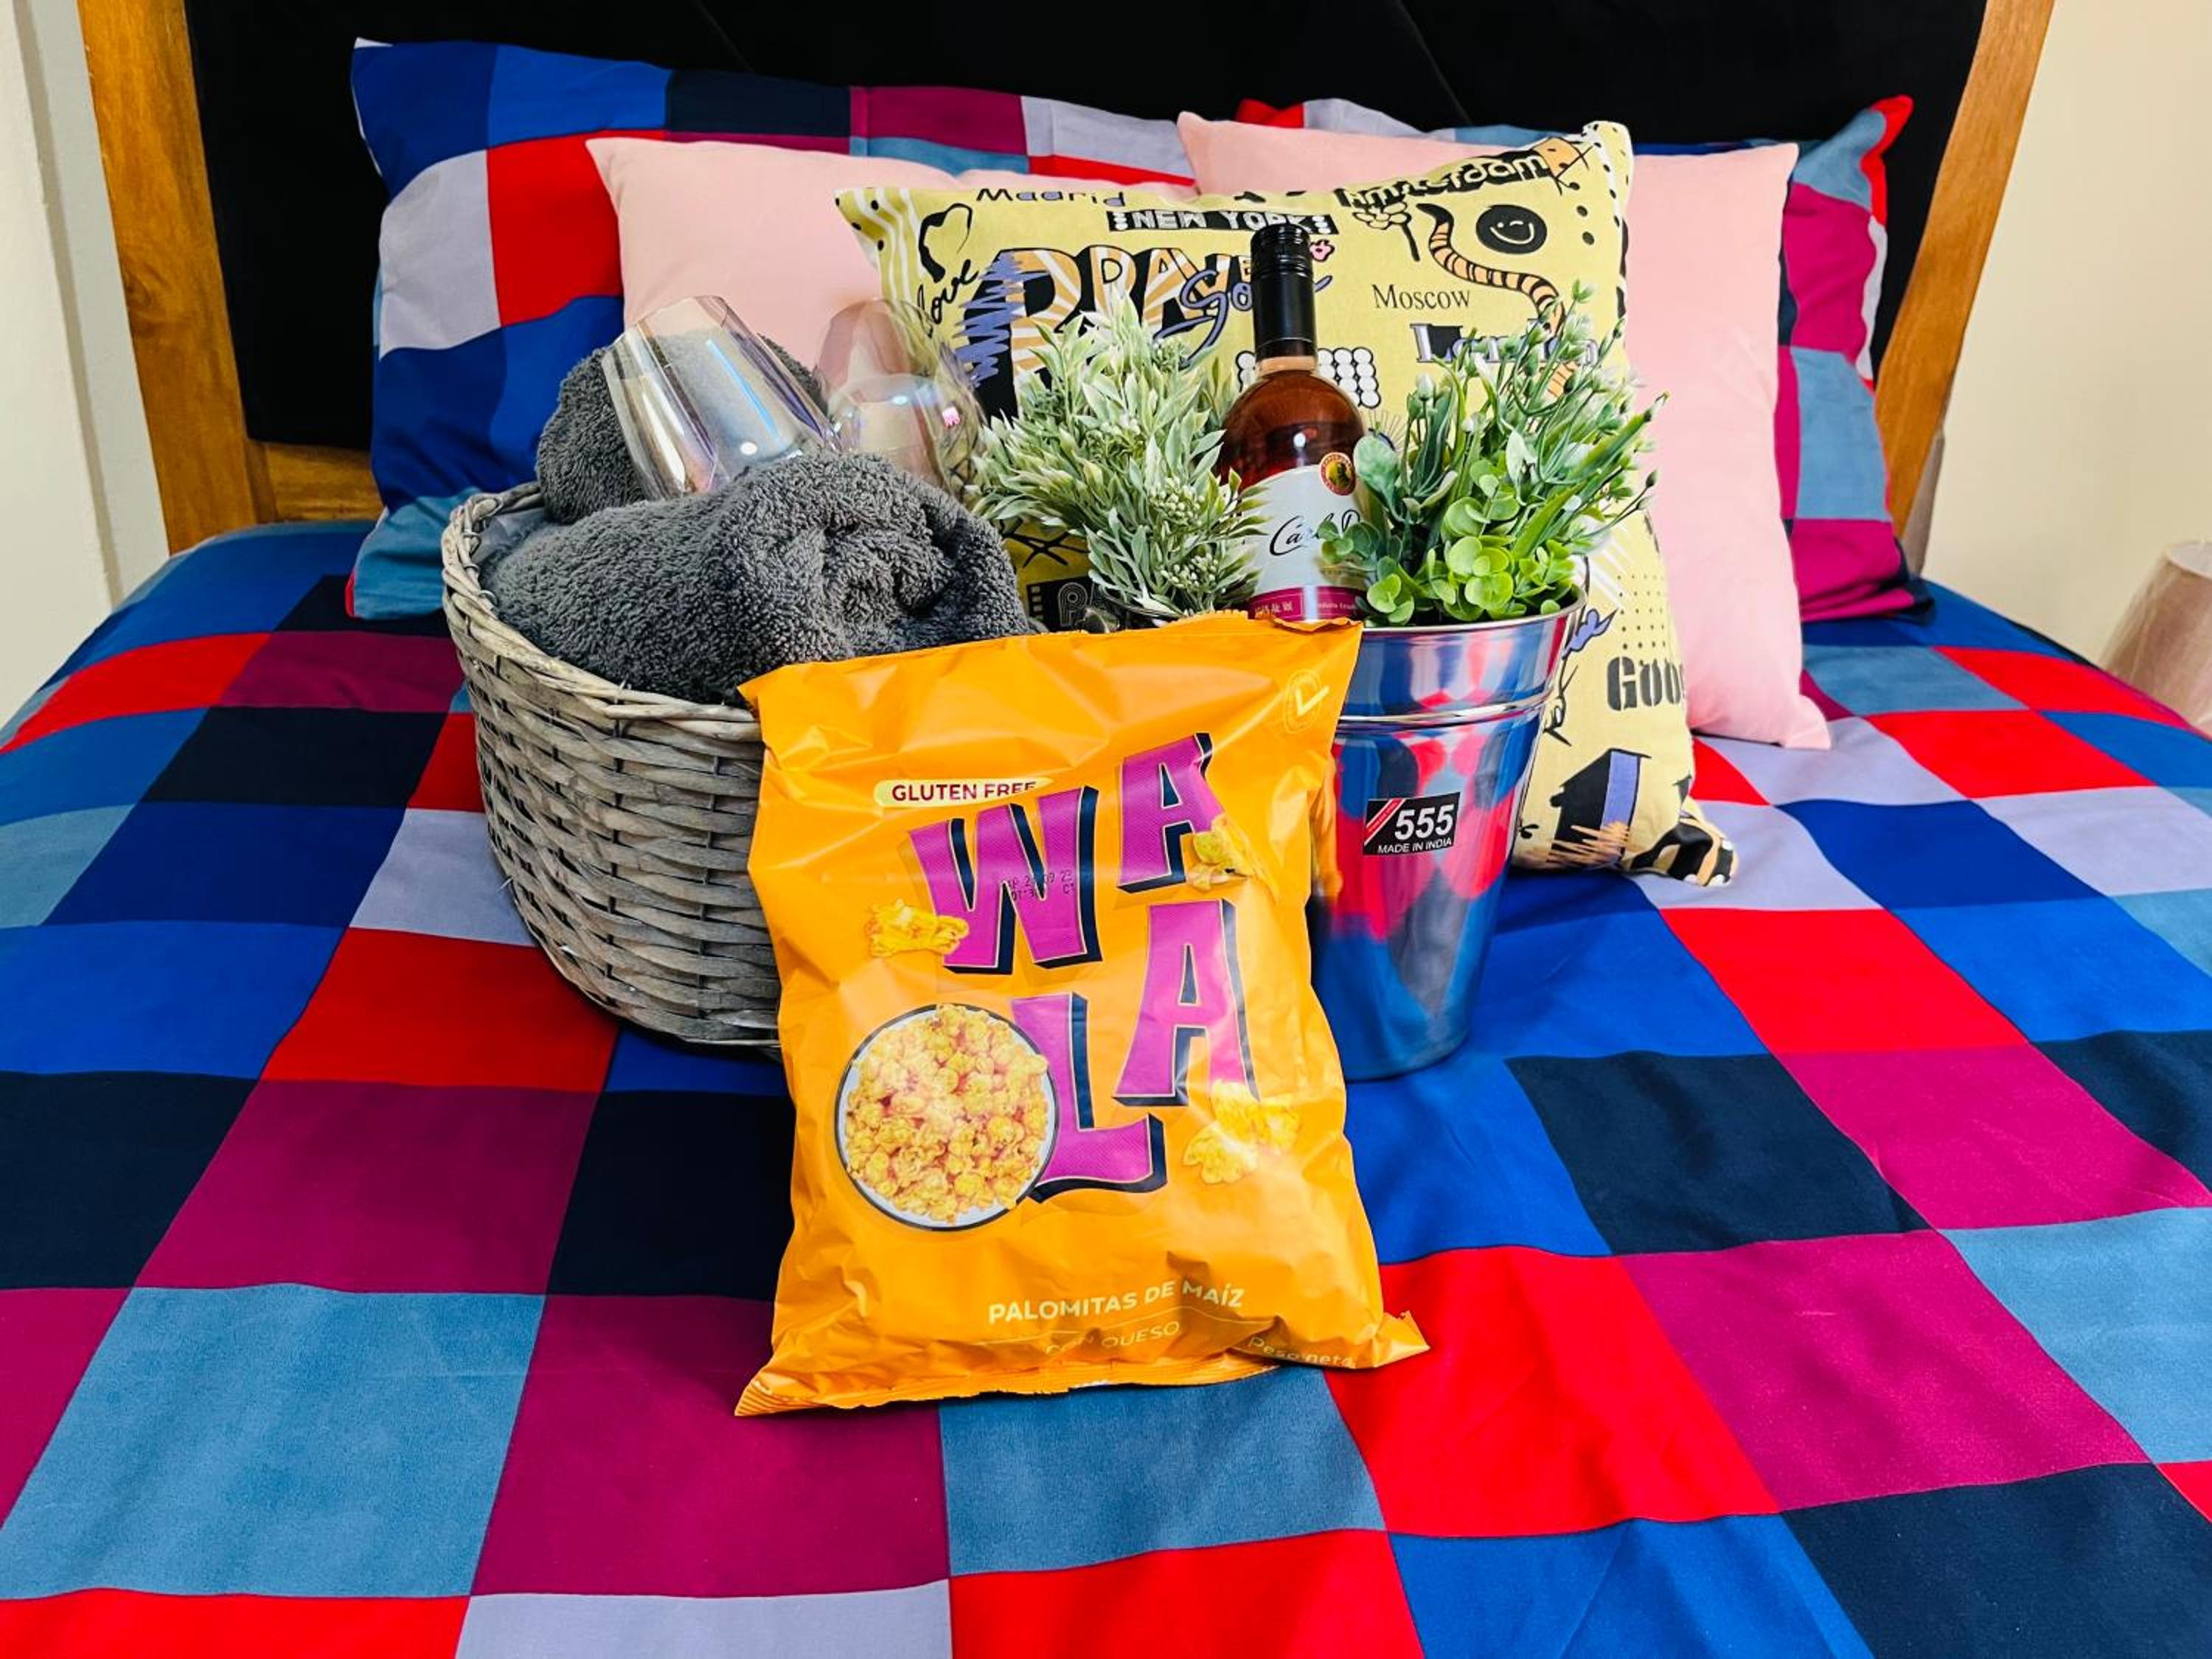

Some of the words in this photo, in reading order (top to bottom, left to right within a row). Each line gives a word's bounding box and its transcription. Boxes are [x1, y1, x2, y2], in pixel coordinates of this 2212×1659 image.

[1335, 153, 1550, 207] Amerdam
[1133, 209, 1207, 230] NEW
[1371, 283, 1470, 310] Moscow
[891, 784, 977, 801] GLUTEN
[984, 781, 1037, 798] FREE
[1394, 804, 1455, 841] 555
[1377, 842, 1410, 854] MADE
[1412, 841, 1424, 852] IN
[1425, 837, 1453, 850] INDIA
[988, 1293, 1138, 1325] PALOMITAS
[1144, 1280, 1176, 1304] DE
[1182, 1279, 1245, 1308] MAÍZ
